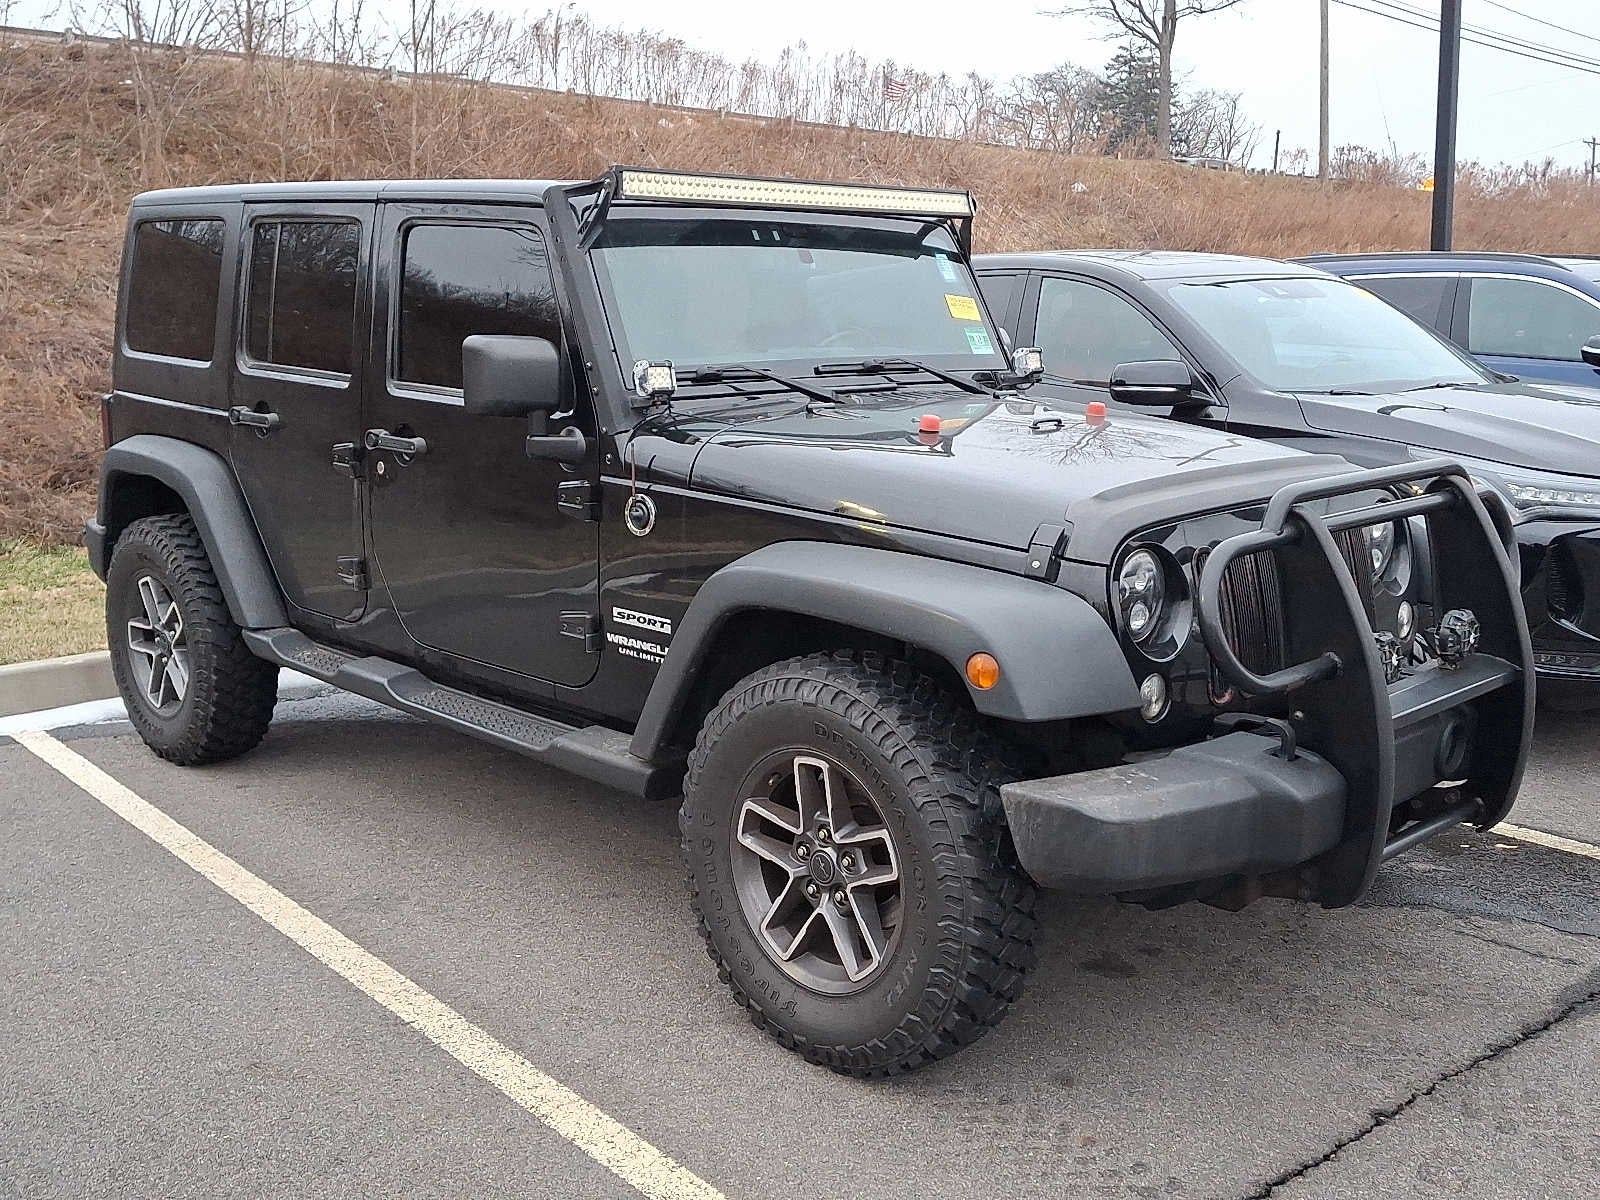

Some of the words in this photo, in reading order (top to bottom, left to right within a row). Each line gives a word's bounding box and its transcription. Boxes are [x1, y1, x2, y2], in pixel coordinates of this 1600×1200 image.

[613, 609, 672, 631] SPORT
[606, 632, 670, 655] WRANGL
[618, 646, 665, 664] UNLIMIT
